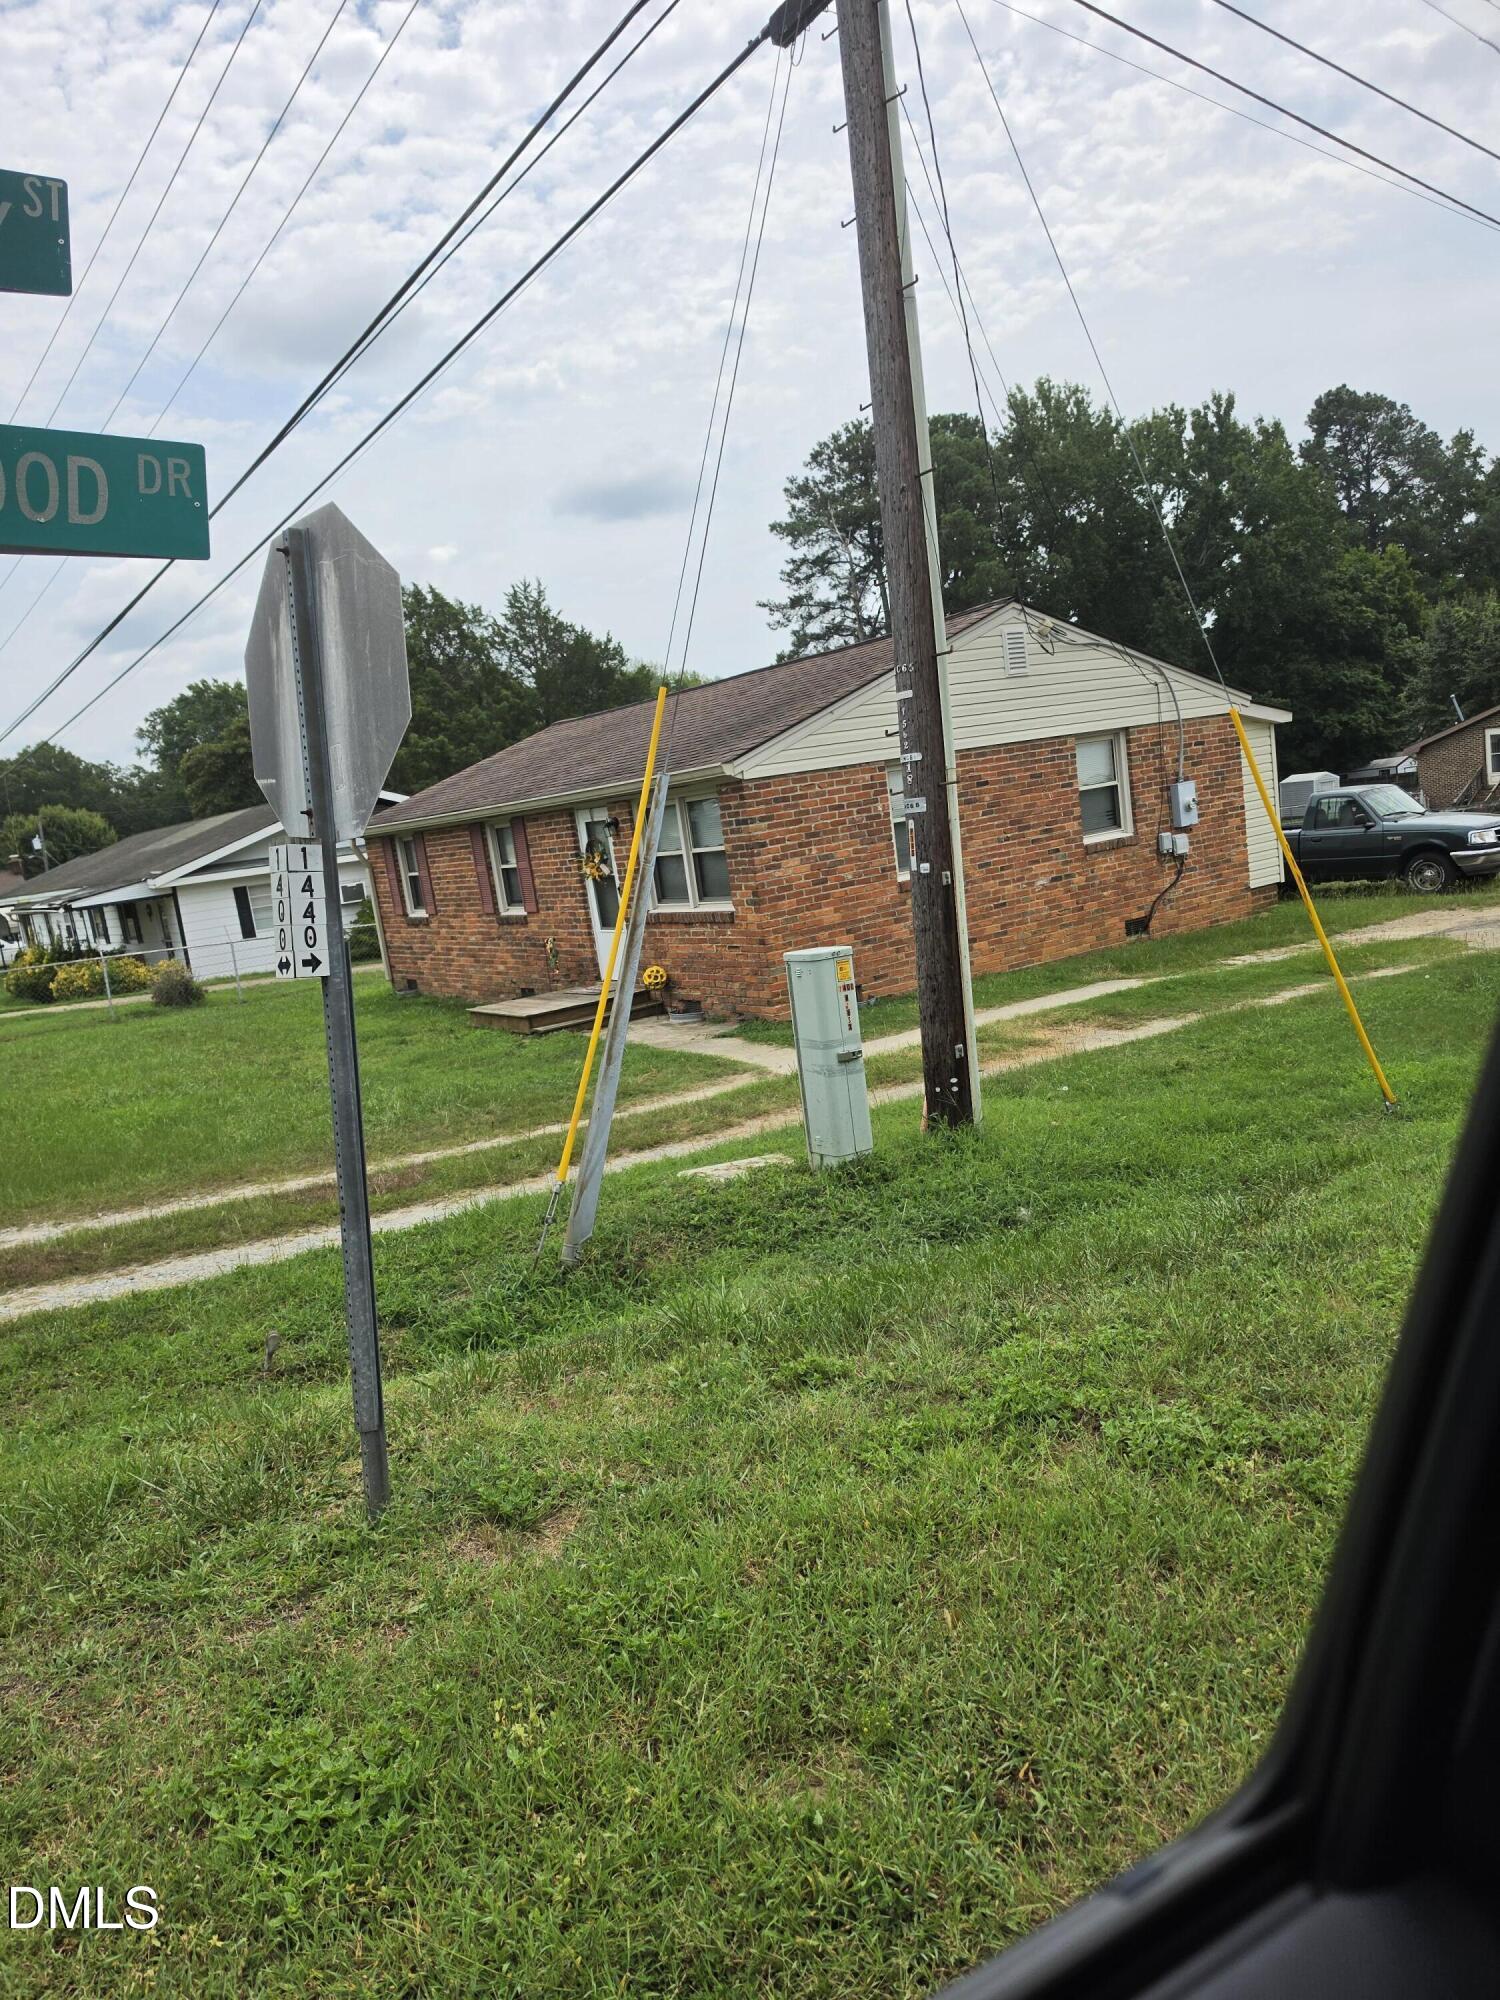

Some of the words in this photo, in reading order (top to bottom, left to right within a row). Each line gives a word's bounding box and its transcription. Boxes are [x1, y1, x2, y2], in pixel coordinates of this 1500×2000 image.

[23, 176, 63, 221] ST
[0, 451, 109, 525] OD
[137, 454, 192, 499] DR
[275, 848, 287, 951] 1400
[300, 846, 317, 949] 1440
